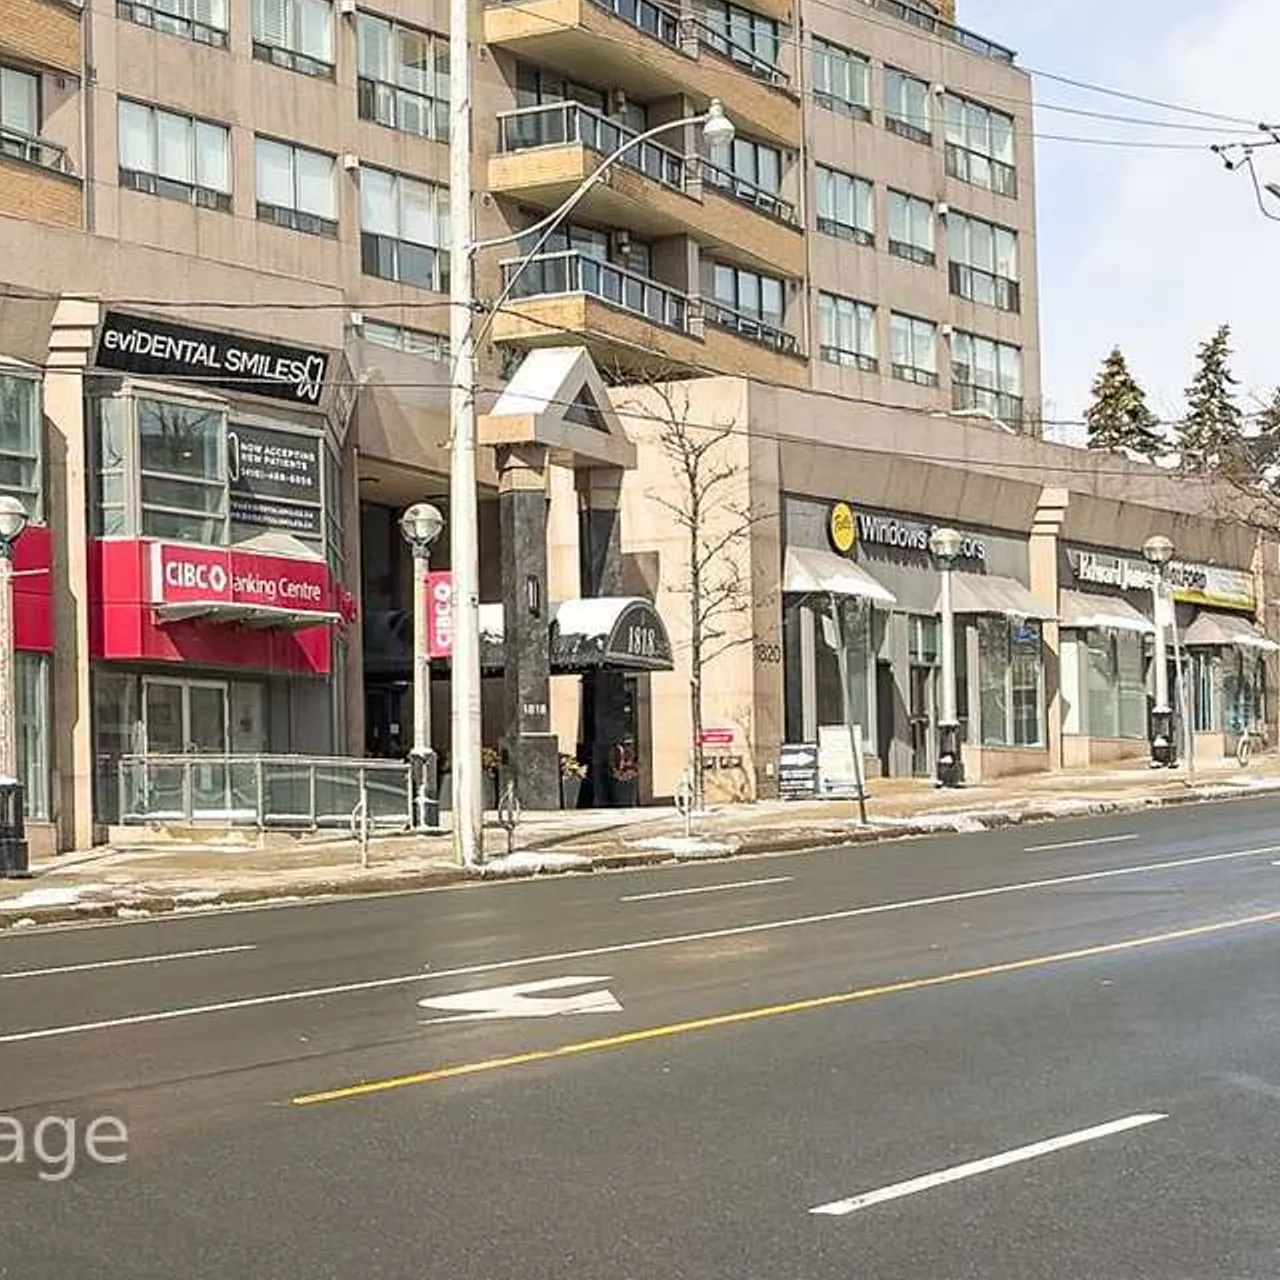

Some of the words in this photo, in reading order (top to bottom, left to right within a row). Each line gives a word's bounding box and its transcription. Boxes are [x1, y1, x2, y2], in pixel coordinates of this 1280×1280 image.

[103, 329, 222, 369] eviDENTAL
[224, 348, 306, 383] SMILES
[860, 514, 928, 550] Windows
[165, 561, 208, 590] CIBC
[229, 573, 277, 601] anking
[278, 577, 322, 602] Centre
[627, 625, 656, 657] 1818
